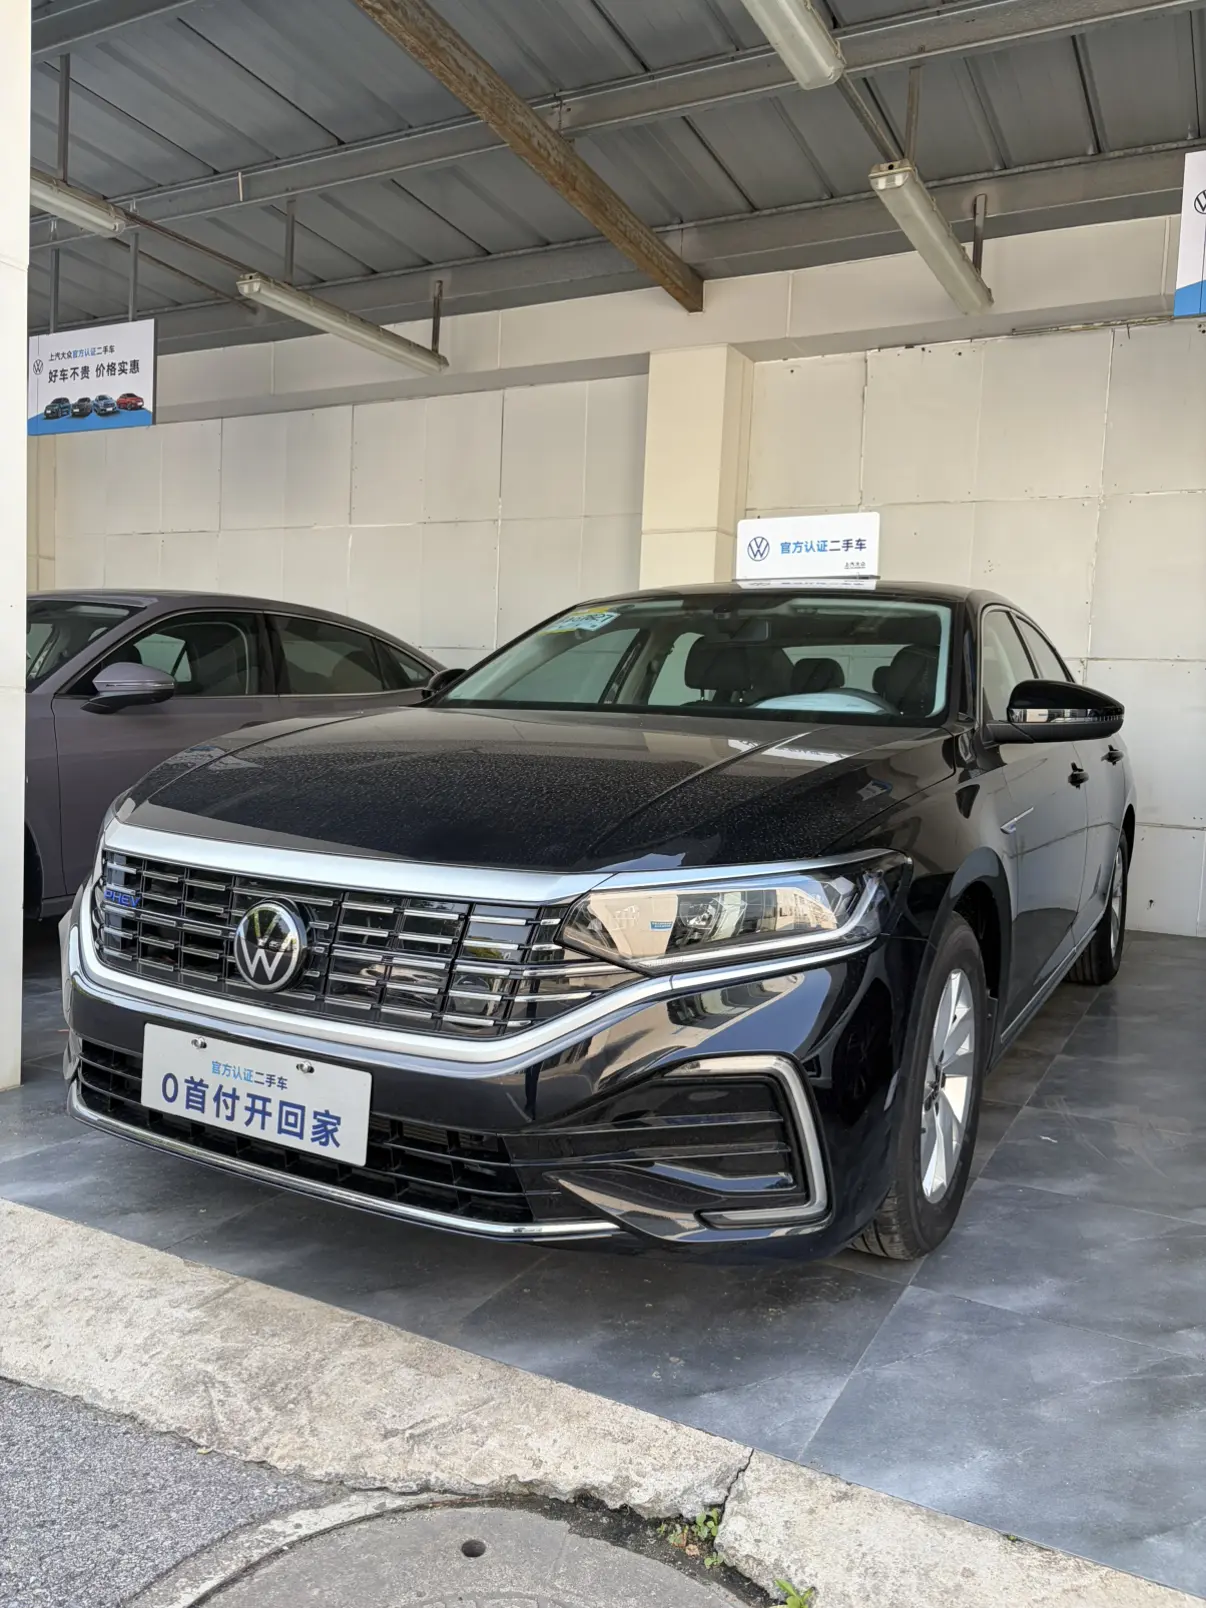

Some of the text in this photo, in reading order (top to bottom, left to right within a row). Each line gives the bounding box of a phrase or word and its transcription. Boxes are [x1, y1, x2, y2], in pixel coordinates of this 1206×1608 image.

[48, 345, 115, 362] 上汽大众官方认证二手车
[48, 359, 140, 383] 好车不贵 价格实惠
[747, 536, 770, 561] VW
[780, 538, 867, 555] 官方认证二手车
[103, 889, 141, 908] PHEV
[211, 1061, 288, 1091] 官方认证二手车
[161, 1073, 342, 1148] 0首付开回家
